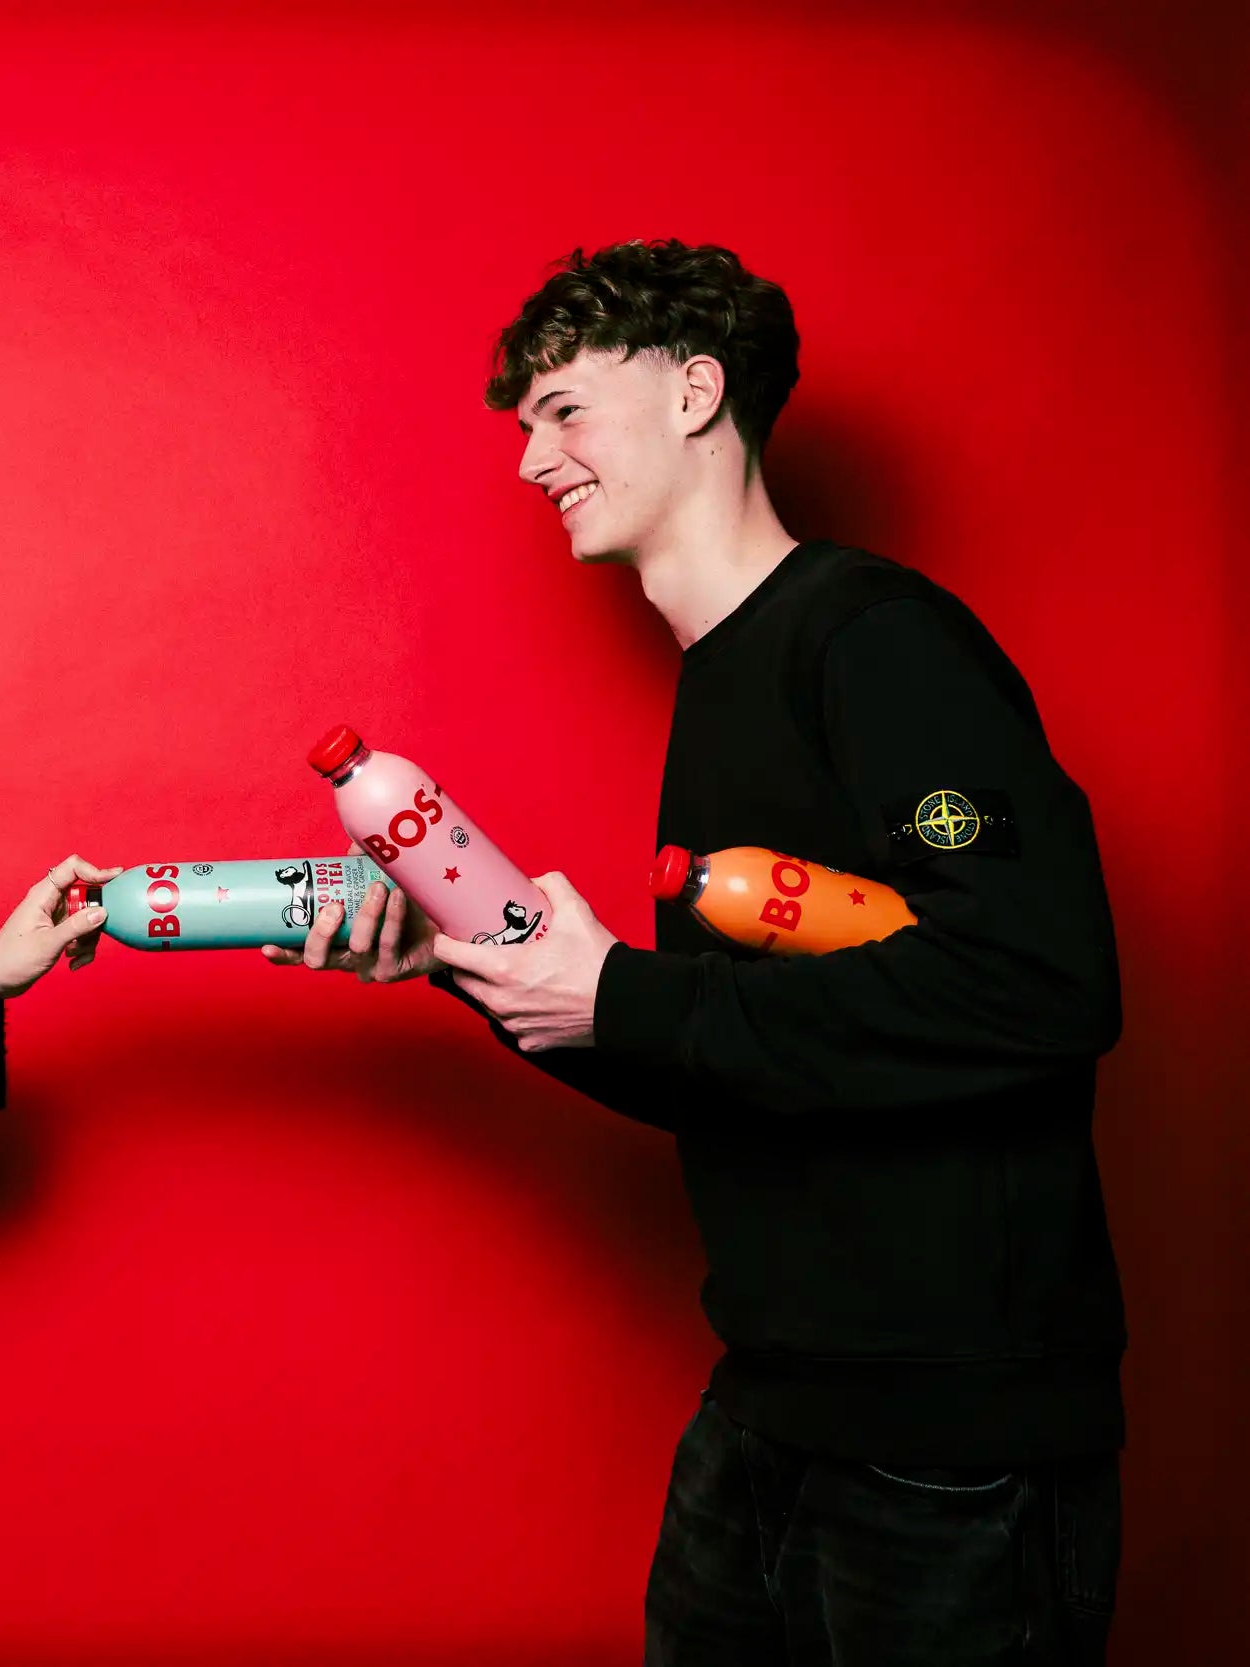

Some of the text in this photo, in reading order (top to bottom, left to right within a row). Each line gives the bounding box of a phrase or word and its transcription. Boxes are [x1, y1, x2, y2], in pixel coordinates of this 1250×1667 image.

[919, 794, 973, 820] STONE ISLAND
[921, 822, 976, 844] STONE ISLAND
[328, 862, 343, 886] TEA
[315, 863, 330, 913] OIBOS
[759, 850, 810, 931] BO
